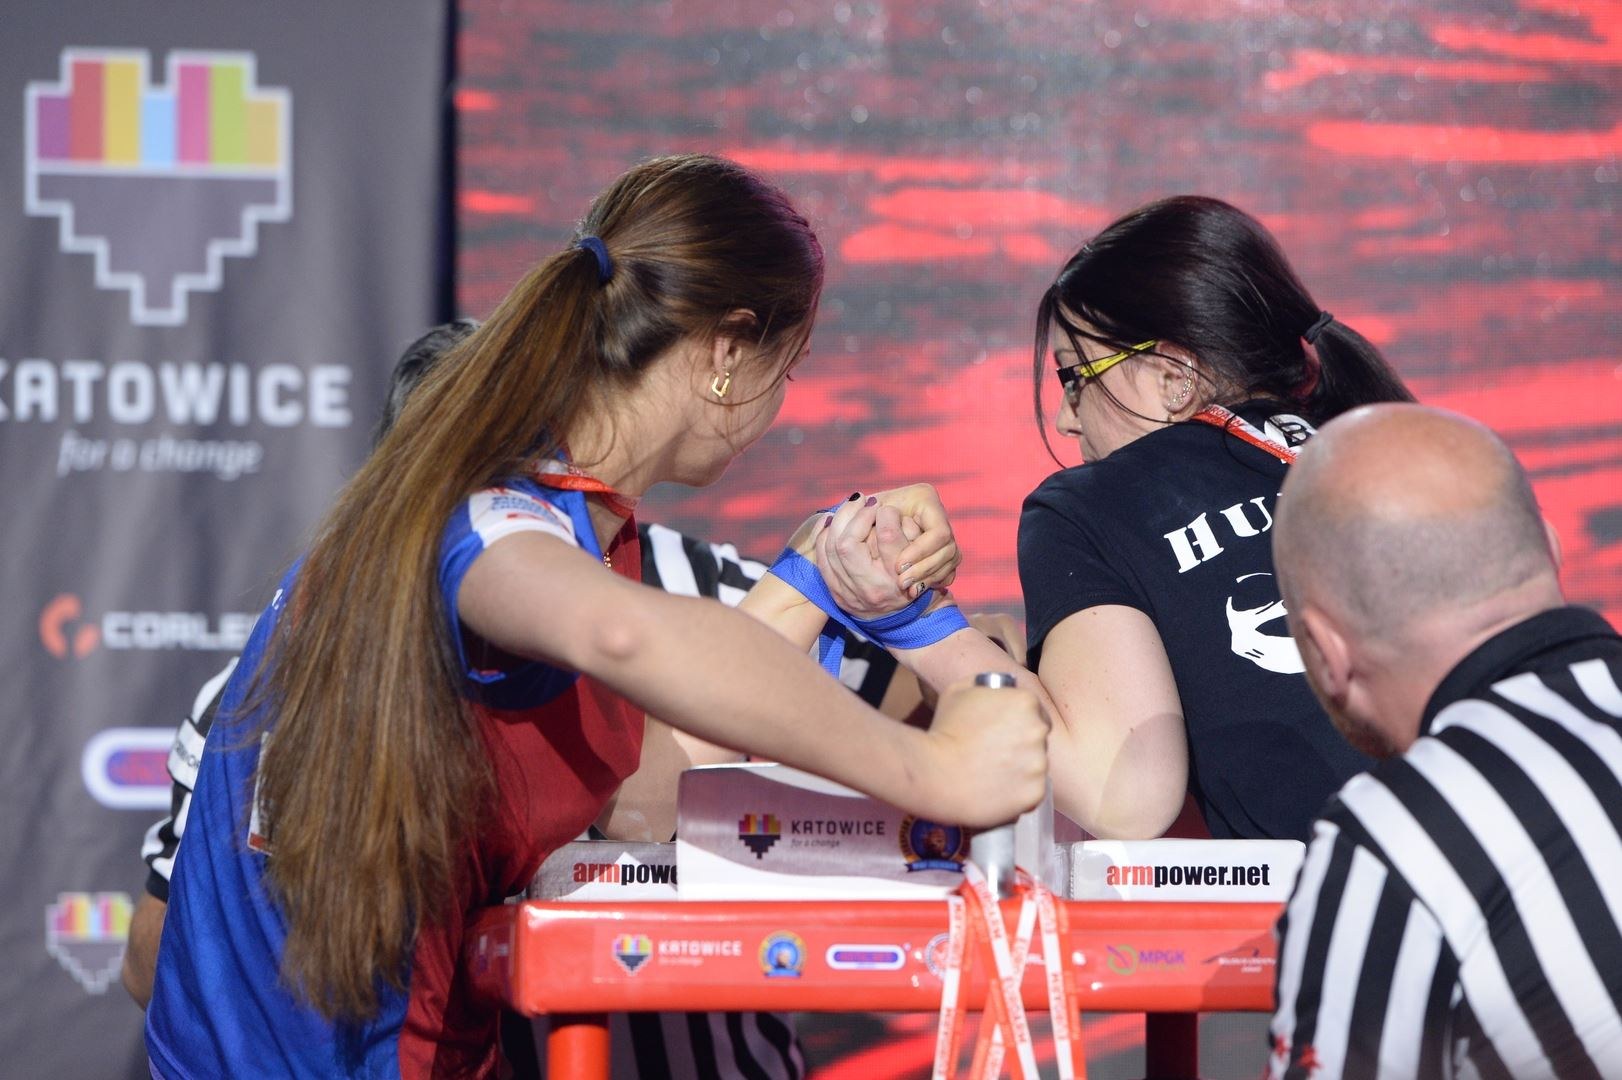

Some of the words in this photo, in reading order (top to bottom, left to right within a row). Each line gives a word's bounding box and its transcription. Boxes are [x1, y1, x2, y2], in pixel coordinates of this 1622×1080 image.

[0, 359, 354, 427] ATOWICE
[57, 430, 106, 478] for
[111, 439, 137, 471] a
[140, 433, 263, 481] change
[1163, 493, 1282, 574] HU
[102, 611, 259, 651] CORLE
[790, 819, 886, 836] KATOWICE
[1106, 863, 1270, 888] armpower.net
[658, 939, 742, 956] KATOWICE
